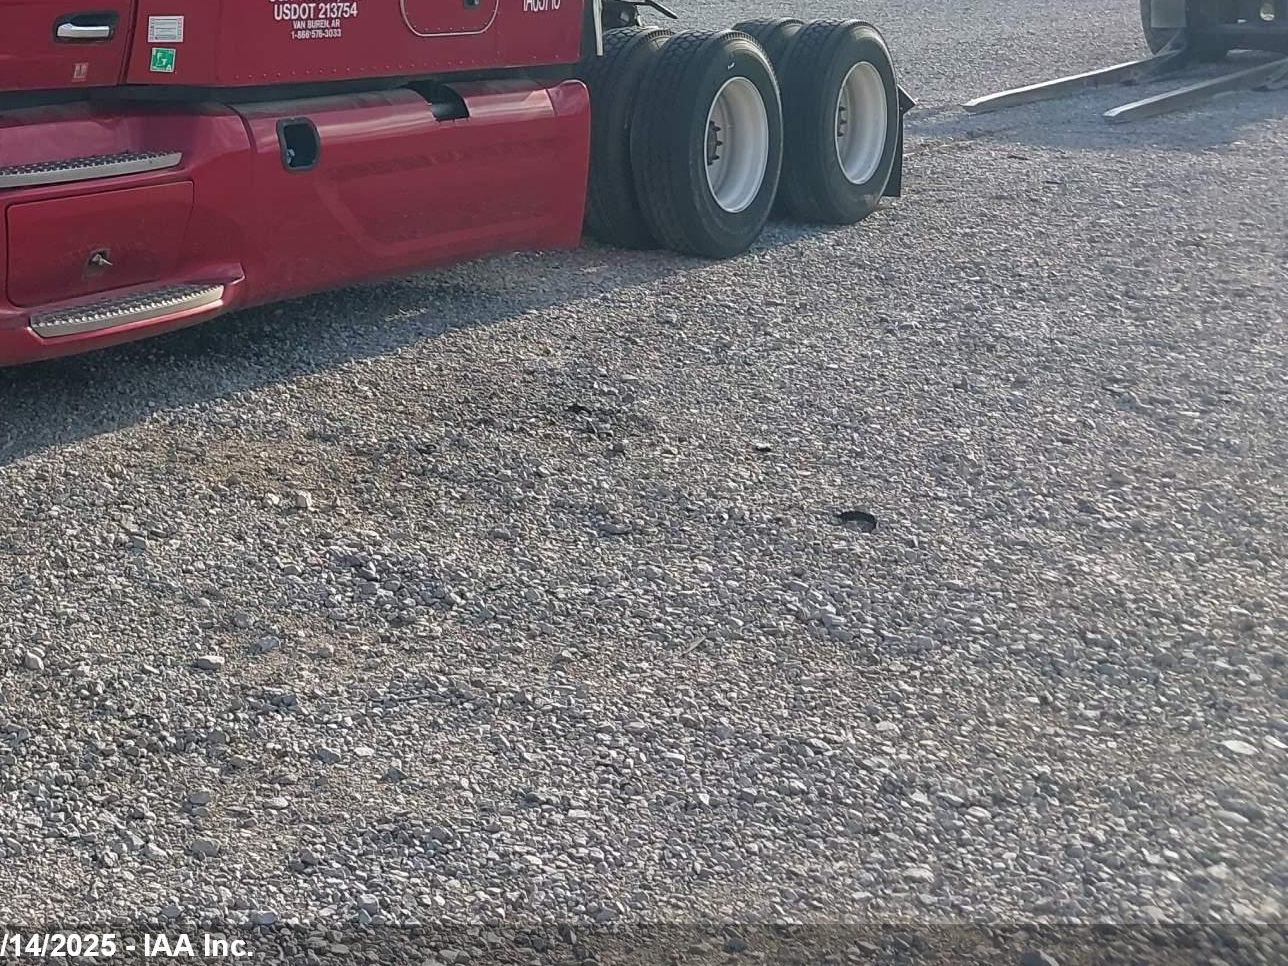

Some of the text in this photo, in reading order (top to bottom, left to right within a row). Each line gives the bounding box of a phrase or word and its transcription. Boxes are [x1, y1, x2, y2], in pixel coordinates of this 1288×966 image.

[274, 2, 358, 20] USDOT 213754
[293, 20, 306, 29] VAN
[331, 19, 340, 28] AR
